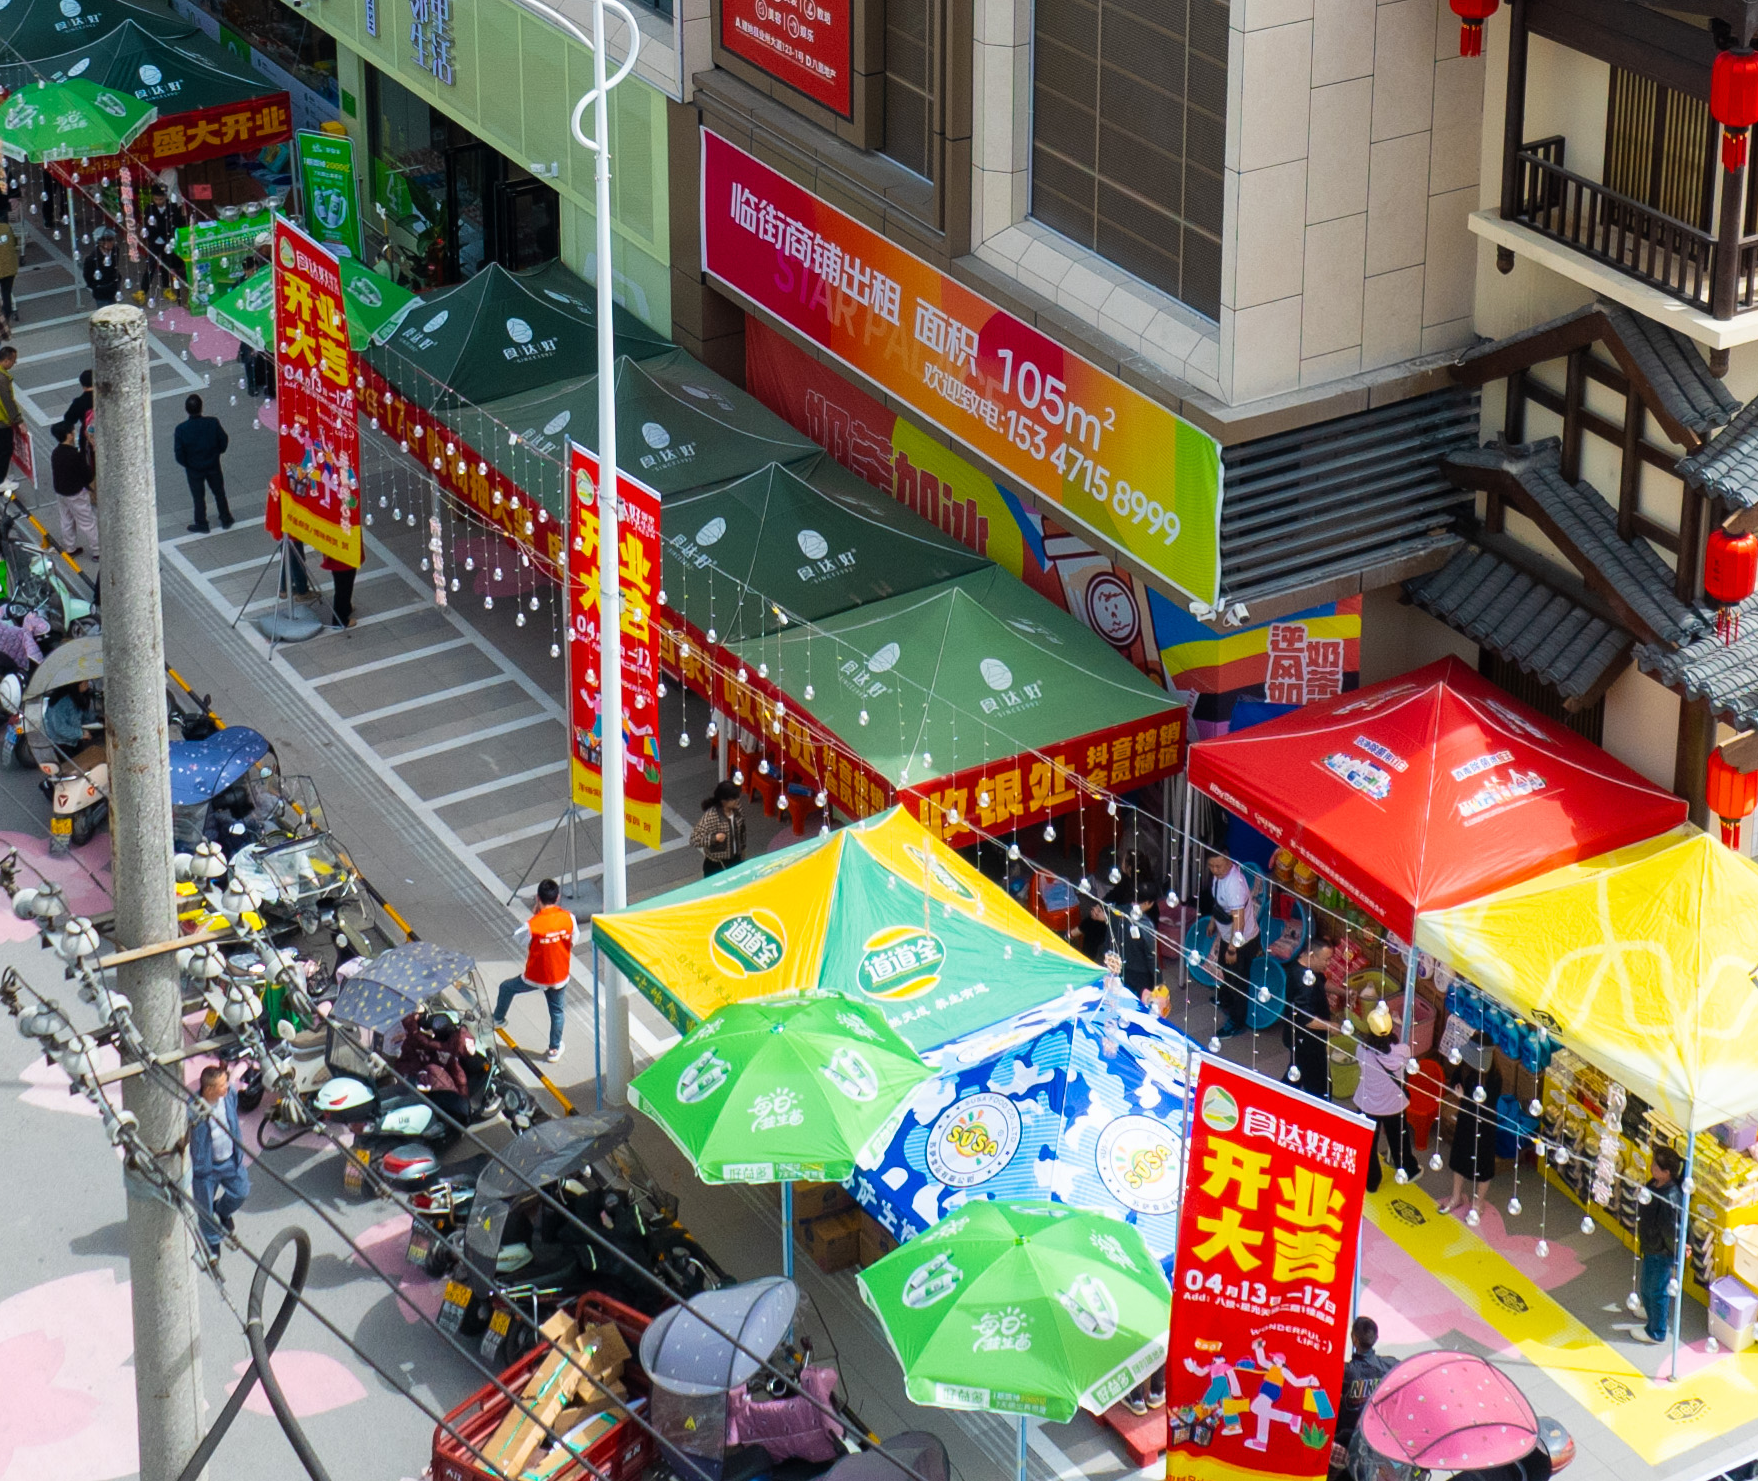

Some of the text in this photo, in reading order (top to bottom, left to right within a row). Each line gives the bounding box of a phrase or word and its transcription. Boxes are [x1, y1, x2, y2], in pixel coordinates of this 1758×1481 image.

[153, 106, 287, 159] 盛大开业
[731, 182, 901, 326] 临街商铺出租
[914, 298, 980, 377] 面积
[284, 271, 345, 346] 开业
[287, 323, 349, 386] 大吉
[503, 341, 557, 362] 食达好
[640, 444, 695, 470] 食达好
[1051, 443, 1109, 504] 4715
[1113, 481, 1181, 546] 8999
[797, 549, 856, 581] 食达好
[841, 659, 890, 698] 食达好
[980, 682, 1043, 714] 食达好
[1087, 721, 1182, 770] 抖音核销
[919, 755, 1076, 841] 收银处
[724, 917, 779, 969] 道道全
[865, 938, 943, 984] 道道全
[947, 1125, 999, 1158] SUSA
[1243, 1106, 1329, 1157] 食达好
[1124, 1145, 1173, 1190] SUSA
[1200, 1136, 1345, 1232] 开业
[1192, 1211, 1341, 1284] 大吉
[1097, 1371, 1132, 1406] 好益多
[1349, 1379, 1379, 1399] NIK
